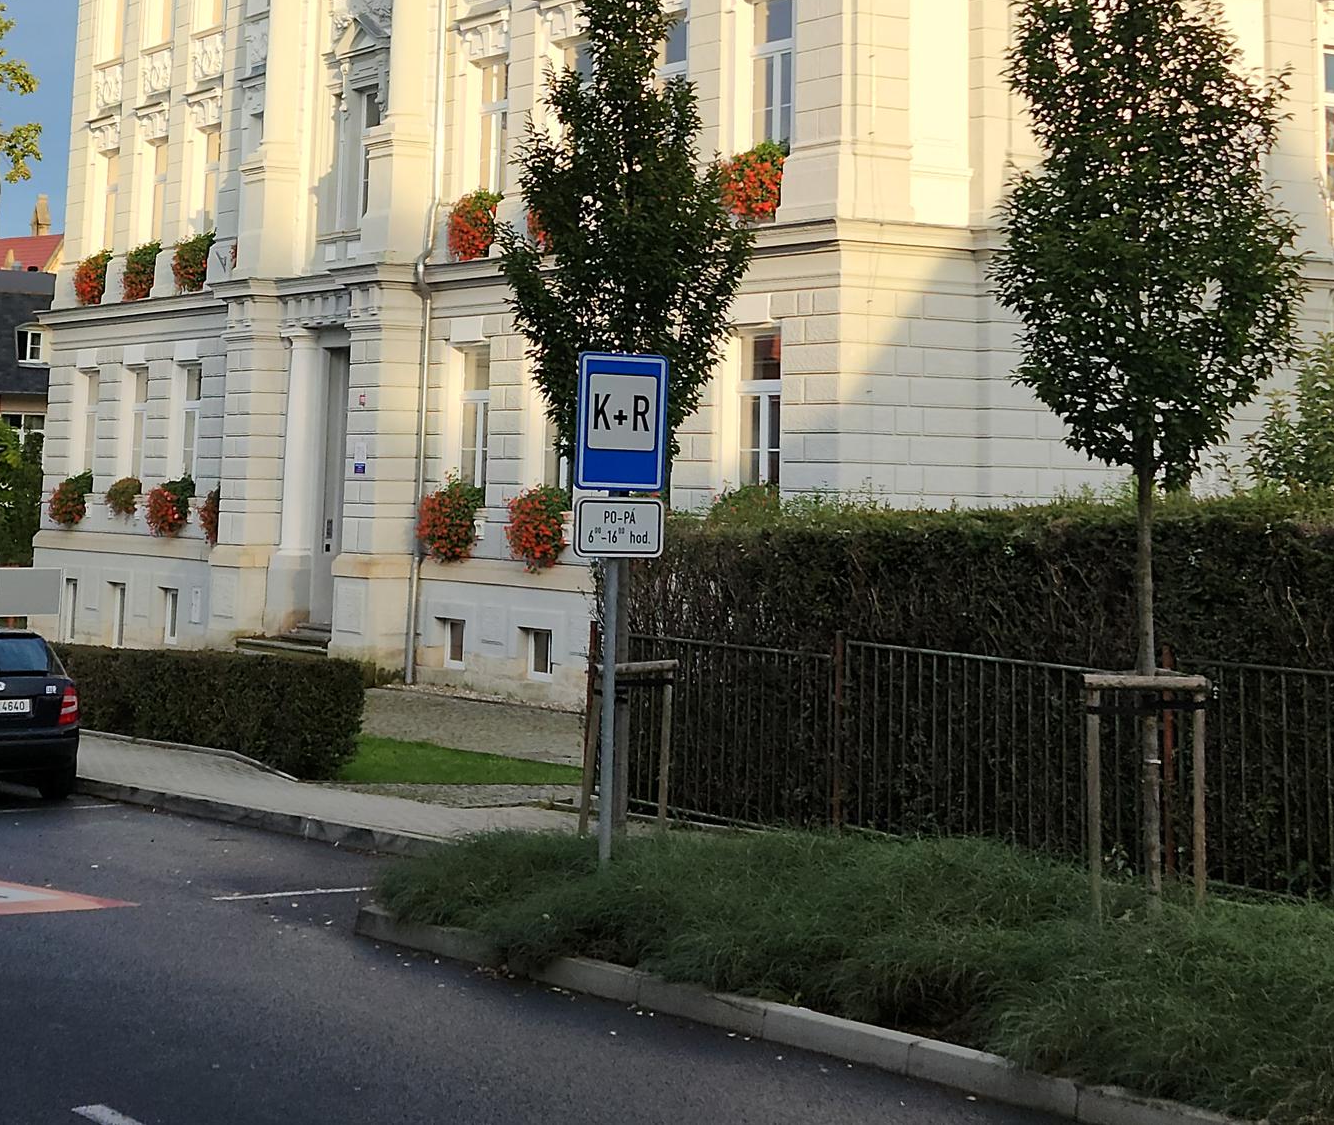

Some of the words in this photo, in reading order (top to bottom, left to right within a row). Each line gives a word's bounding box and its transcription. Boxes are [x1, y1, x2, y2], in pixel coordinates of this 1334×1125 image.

[593, 393, 650, 432] K+R
[604, 507, 636, 525] PO-PÁ
[629, 530, 651, 544] hod.
[1, 700, 26, 712] 4640
